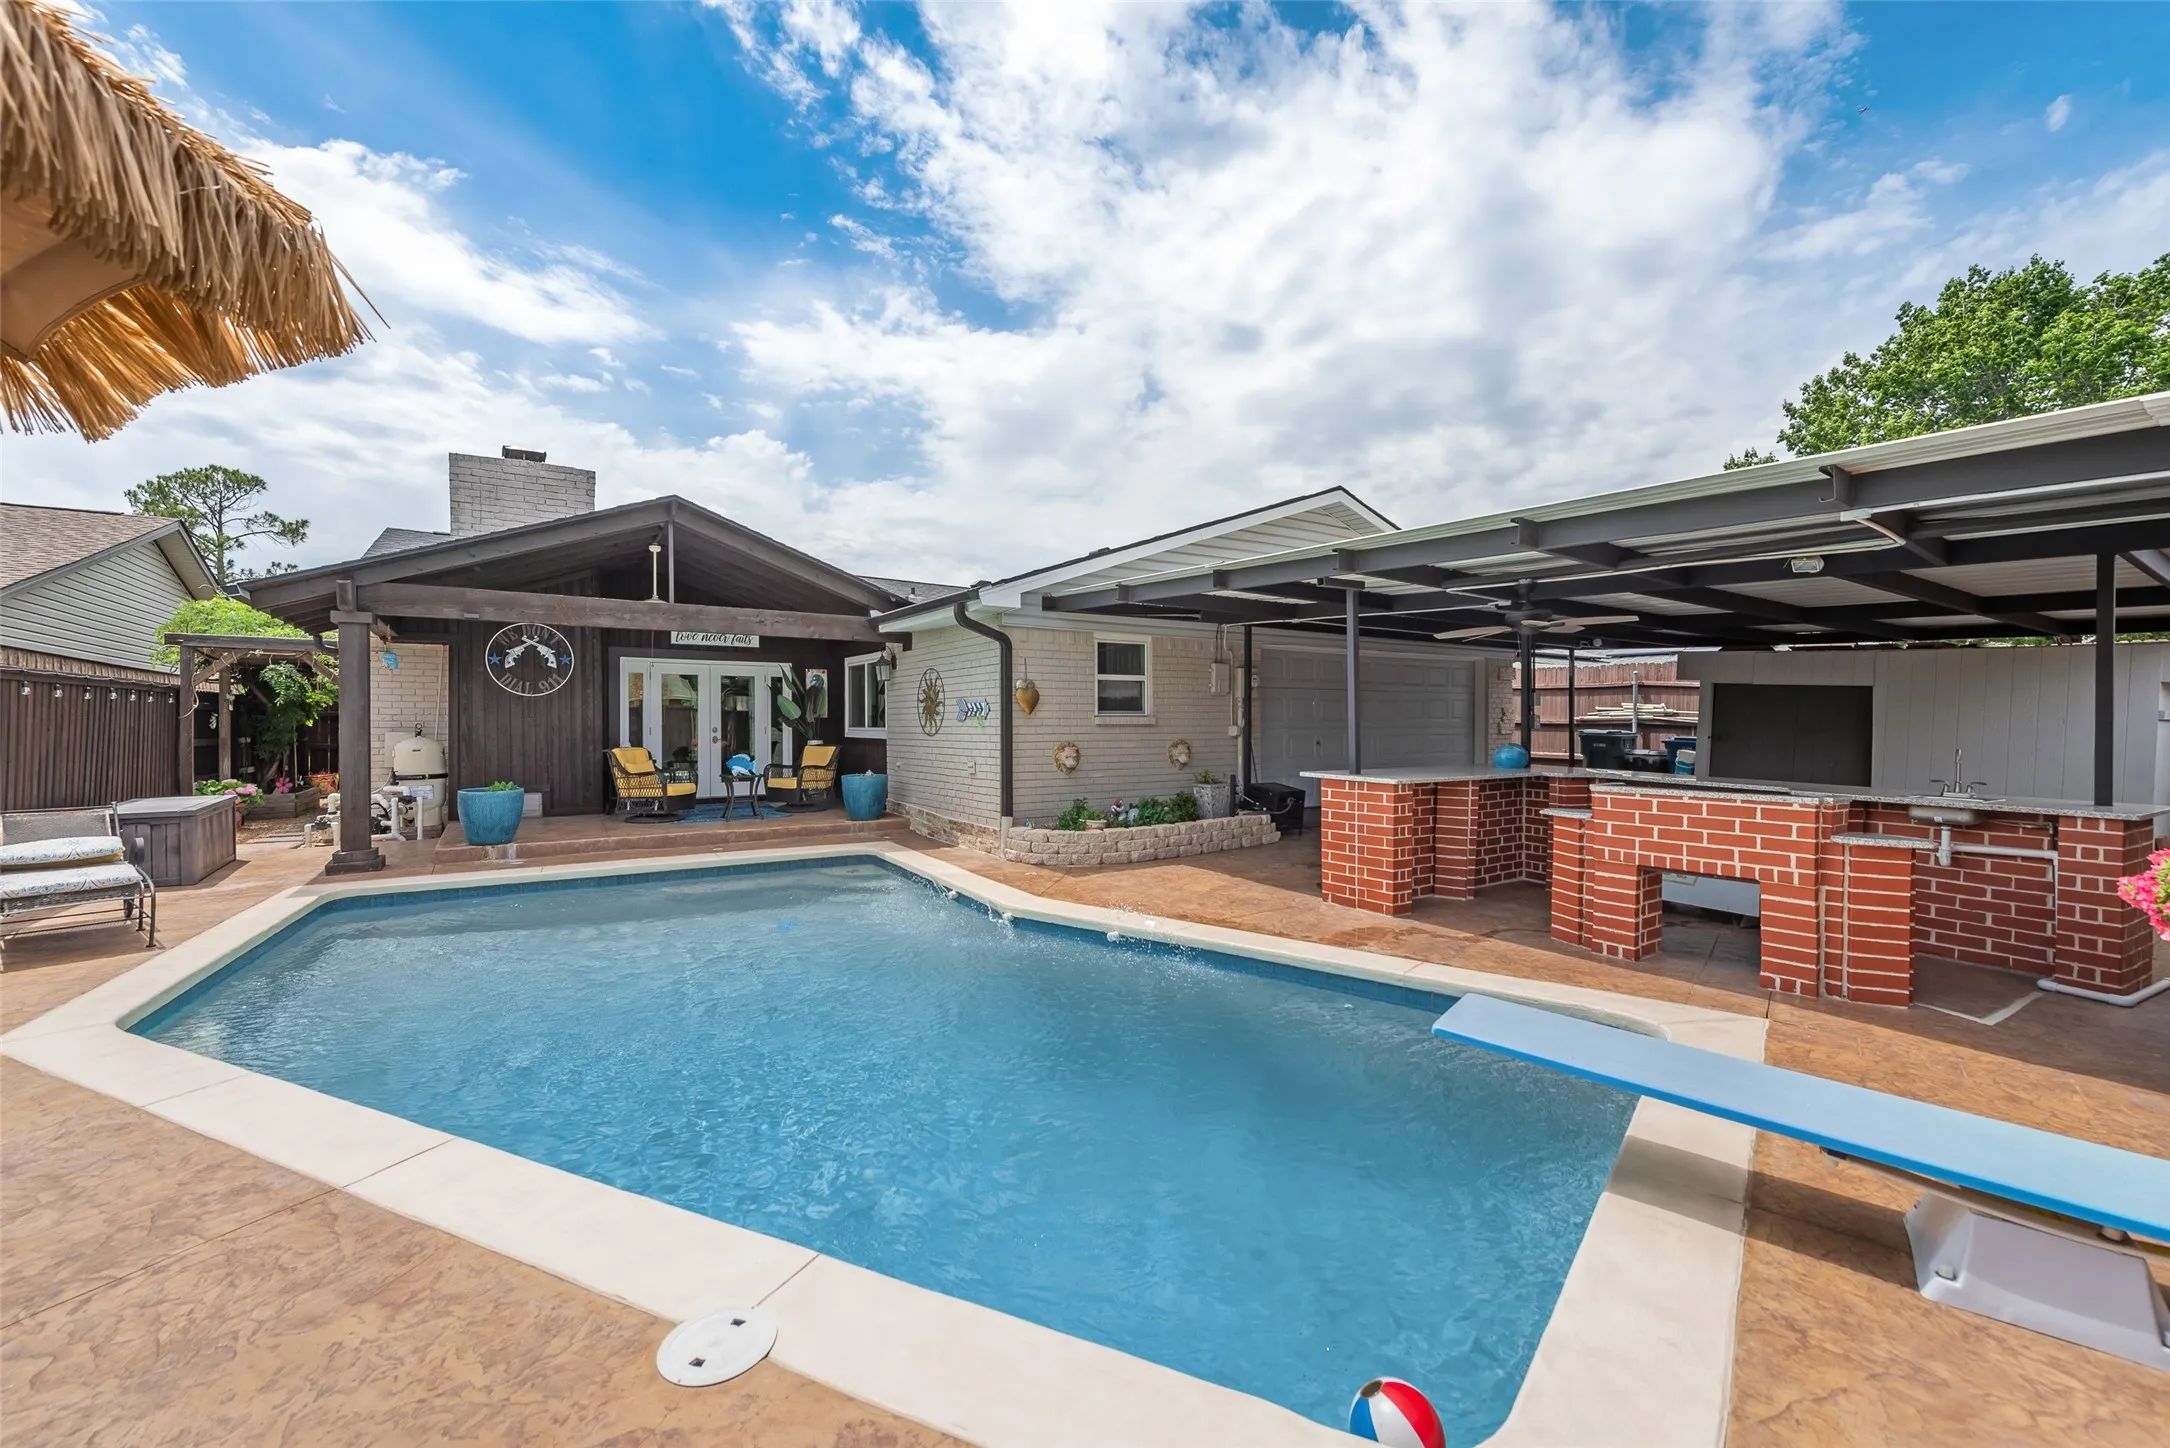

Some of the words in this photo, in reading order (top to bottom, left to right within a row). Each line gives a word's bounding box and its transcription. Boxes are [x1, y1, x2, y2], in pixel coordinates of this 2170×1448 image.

[675, 631, 698, 643] love
[701, 632, 729, 643] never
[730, 634, 754, 646] fails
[499, 672, 534, 695] DIAL
[538, 673, 564, 693] 911
